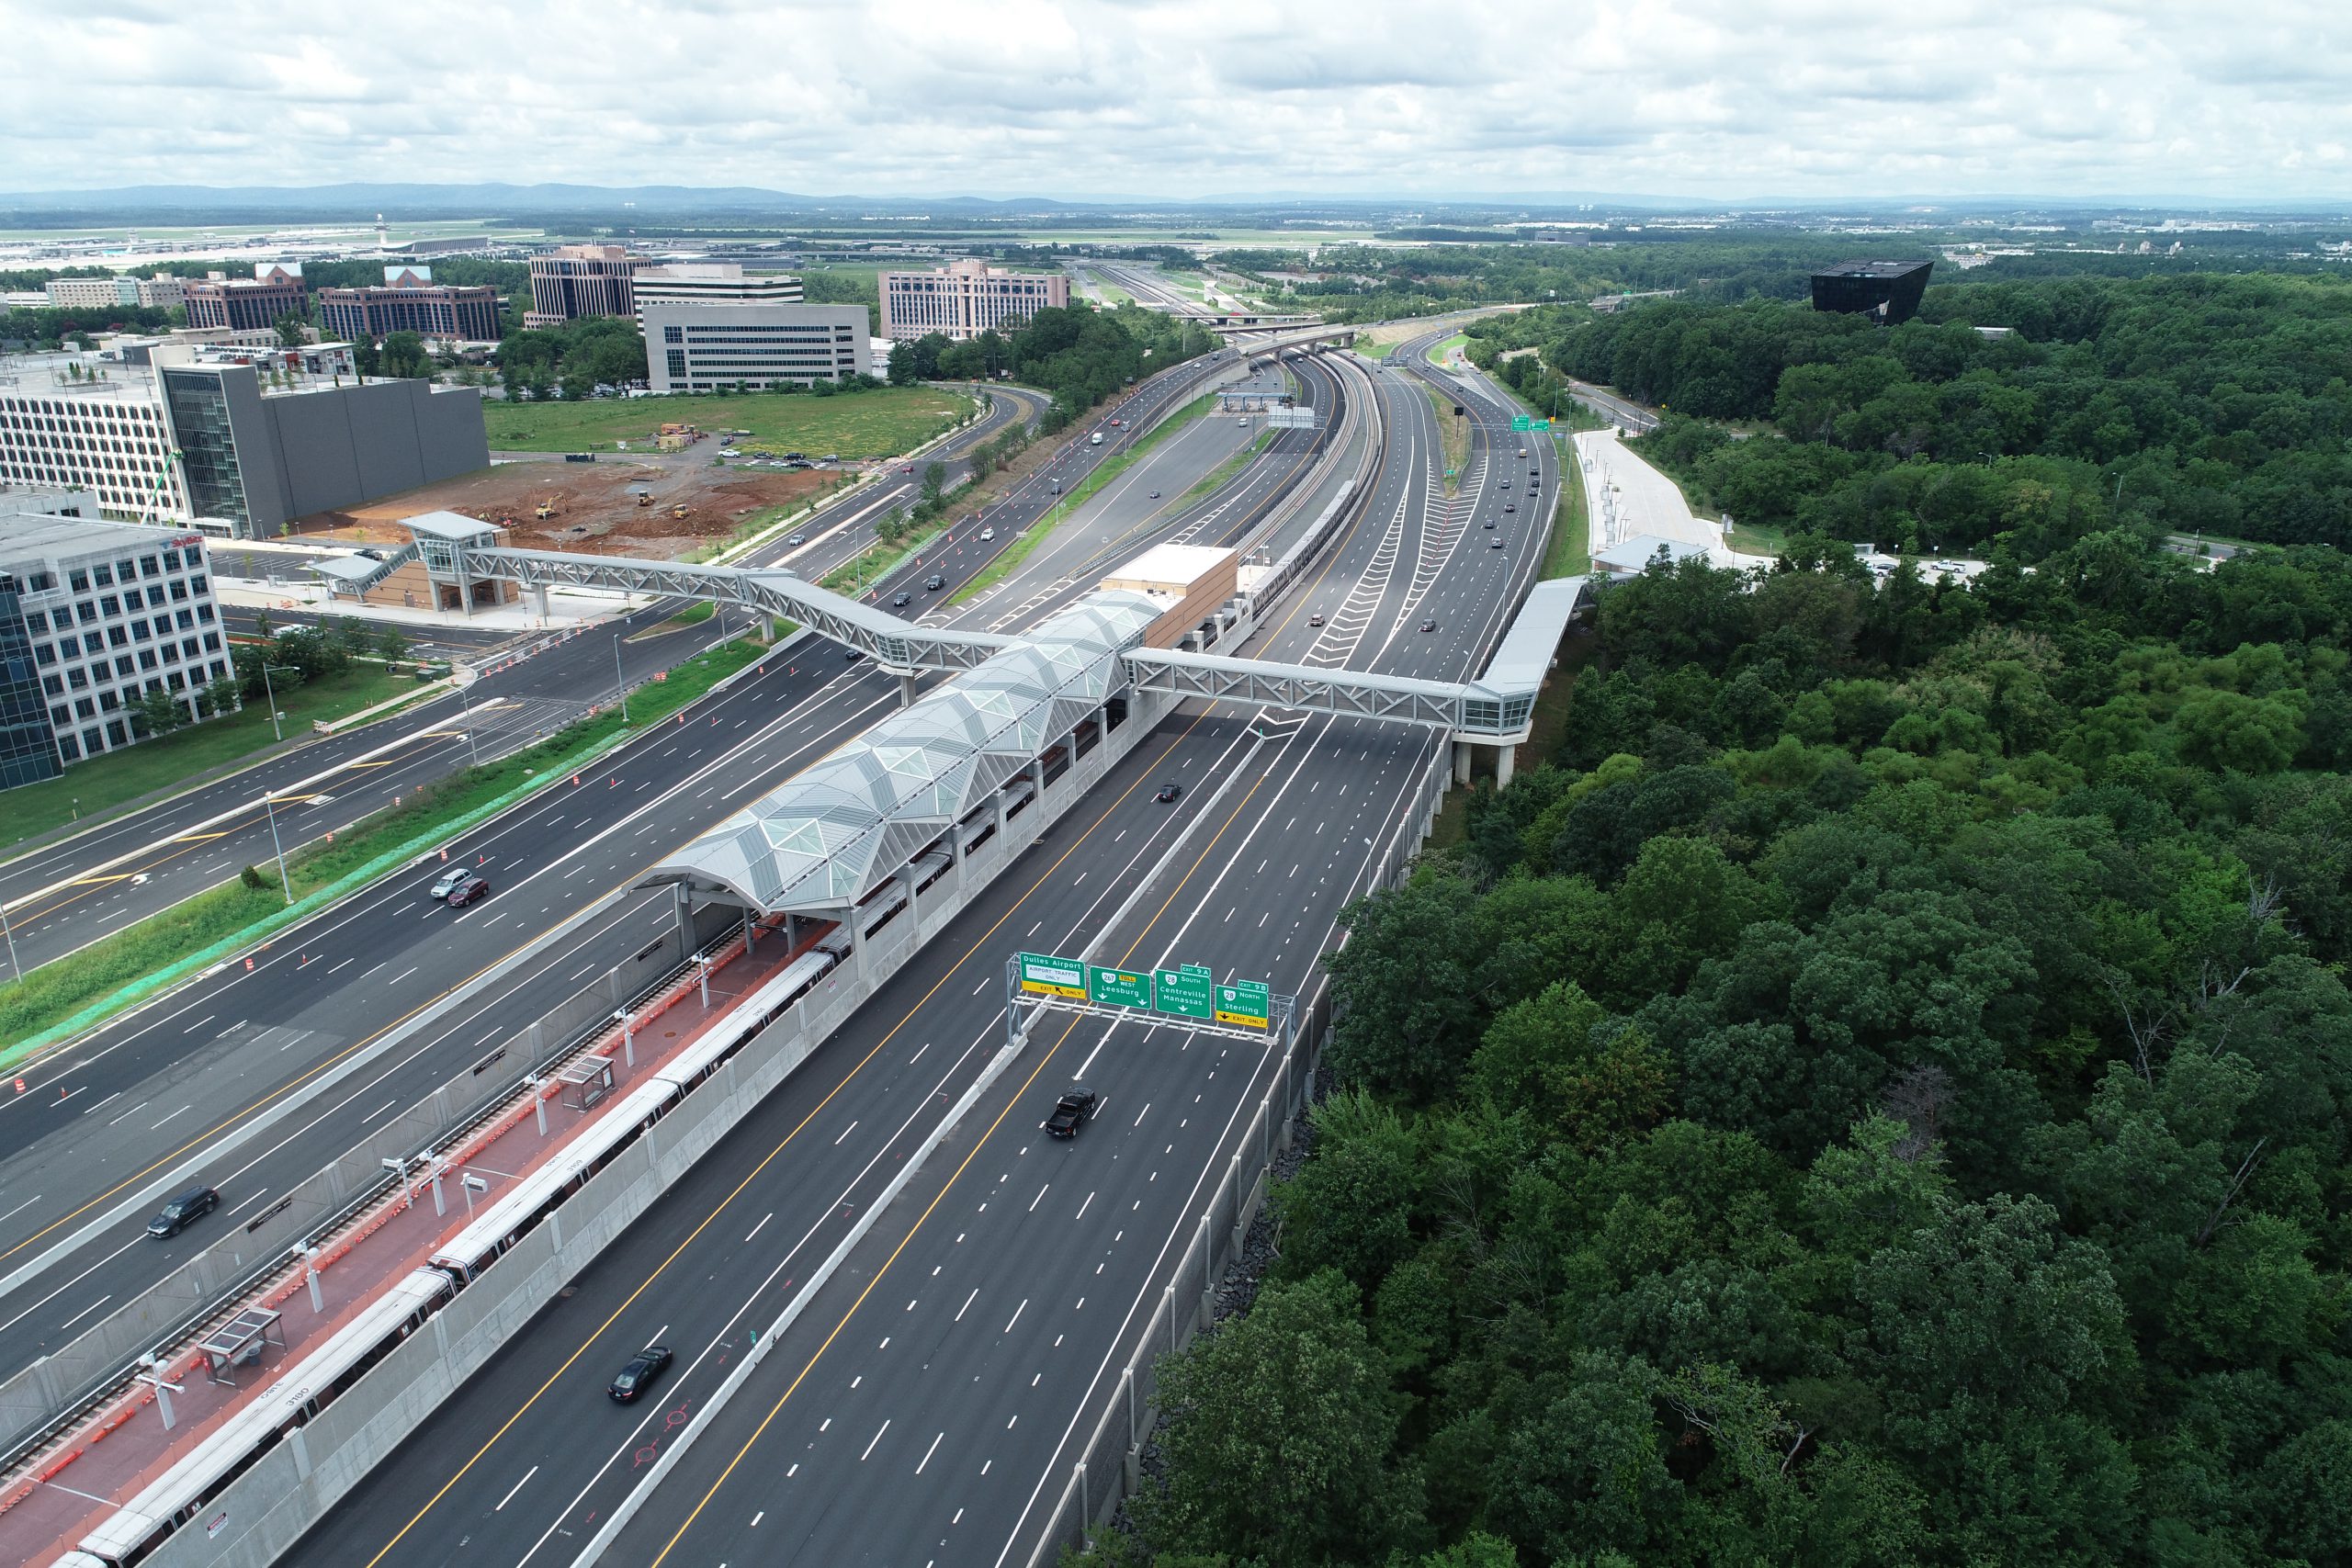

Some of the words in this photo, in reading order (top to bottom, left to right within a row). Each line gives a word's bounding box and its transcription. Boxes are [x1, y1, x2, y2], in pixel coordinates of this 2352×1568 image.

[1023, 955, 1049, 964] Dulles
[1052, 960, 1081, 969] Airport
[1103, 974, 1114, 982] 267
[1102, 985, 1139, 998] Leesburg
[1159, 986, 1206, 998] Centreville
[1163, 994, 1203, 1006] Manassas
[1225, 1003, 1259, 1015] Sterling
